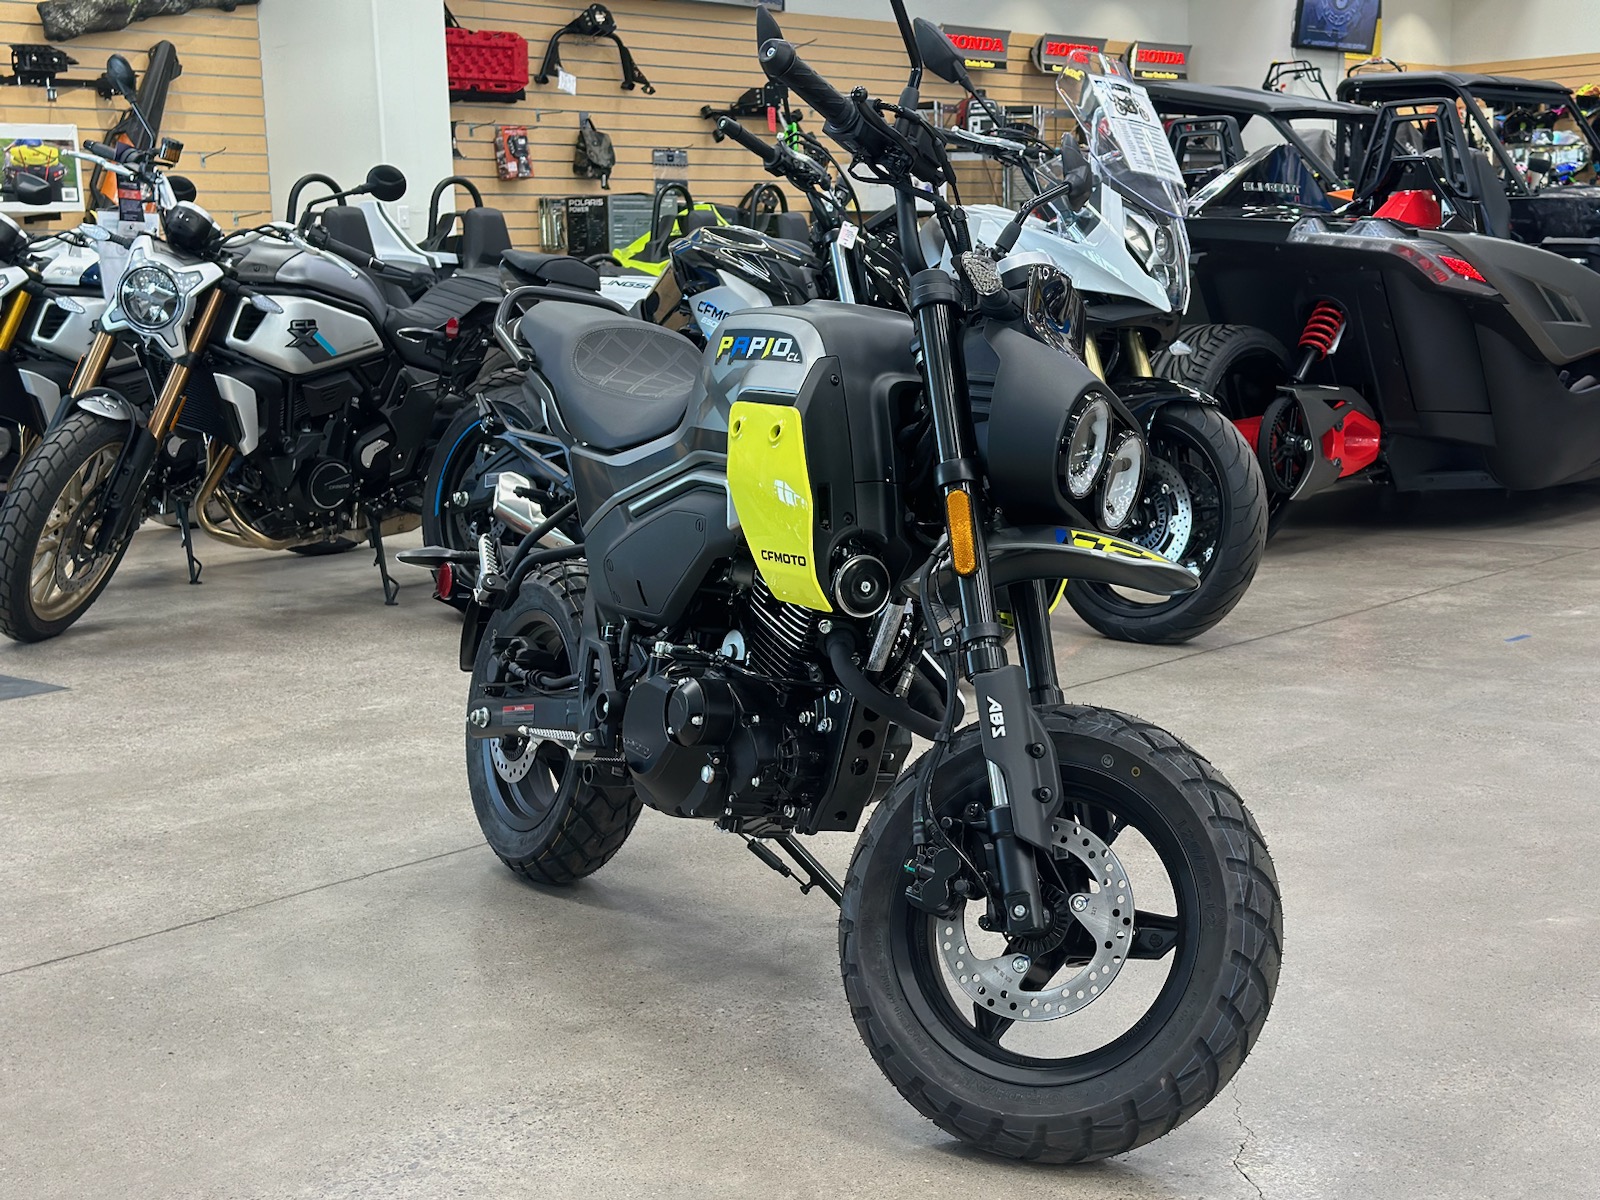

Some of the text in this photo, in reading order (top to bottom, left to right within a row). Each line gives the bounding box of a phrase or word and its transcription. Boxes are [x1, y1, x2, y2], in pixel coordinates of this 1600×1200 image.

[1137, 49, 1186, 65] HONDA
[568, 198, 604, 206] POLARIS
[716, 336, 801, 363] PAPIO CL
[761, 549, 807, 567] CFMOTO
[986, 695, 1006, 738] ABS
